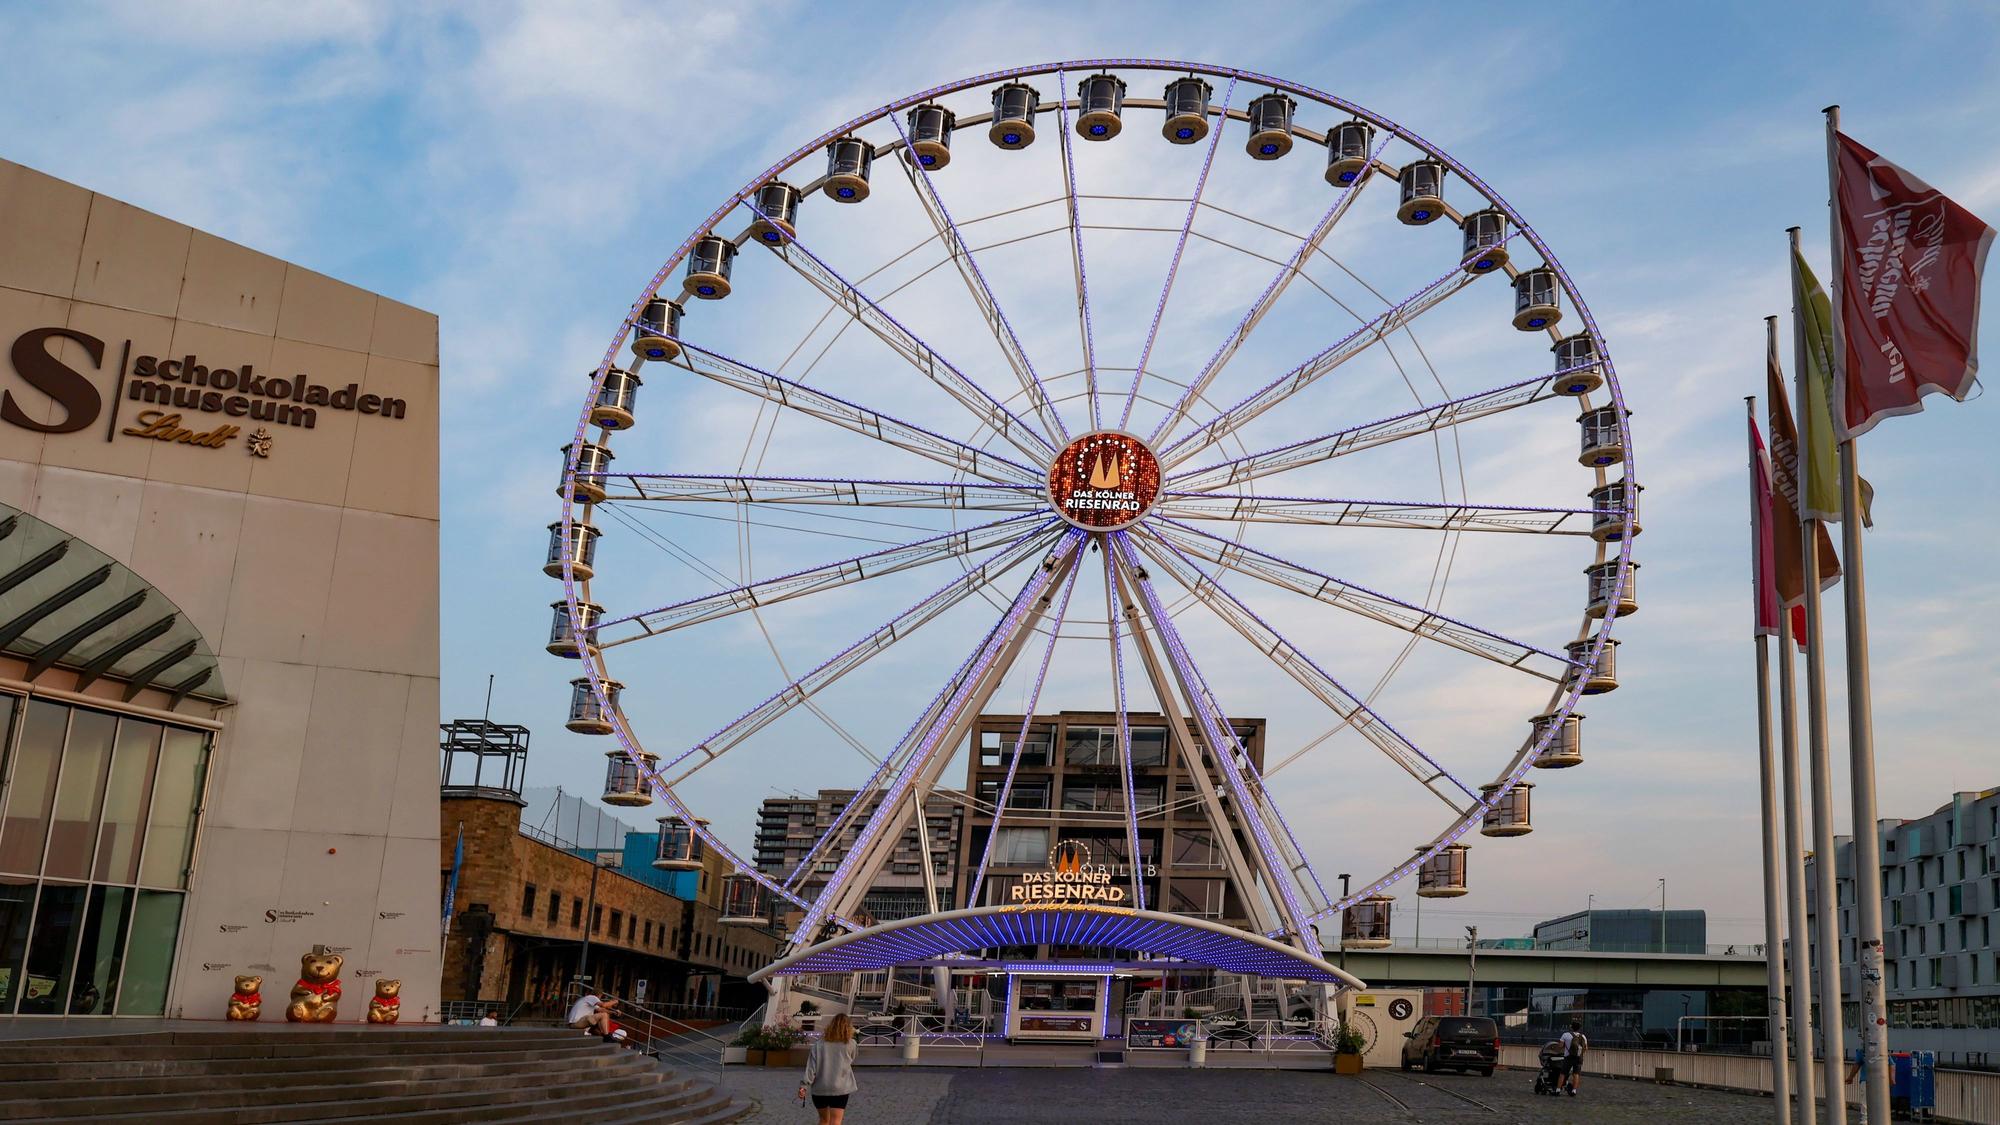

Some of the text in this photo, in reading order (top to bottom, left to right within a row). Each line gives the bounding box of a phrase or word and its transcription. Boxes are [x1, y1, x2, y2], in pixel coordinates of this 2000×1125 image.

[1, 327, 105, 434] S
[133, 354, 407, 420] schokoladen
[128, 377, 317, 429] museum
[122, 410, 241, 450] Lindt
[1073, 489, 1134, 500] DAS KÖLNER
[1065, 499, 1140, 511] RIESENRAD
[1022, 866, 1111, 885] DAS KÖLNER
[1011, 884, 1125, 902] RIESENRAD
[1395, 1003, 1406, 1017] S
